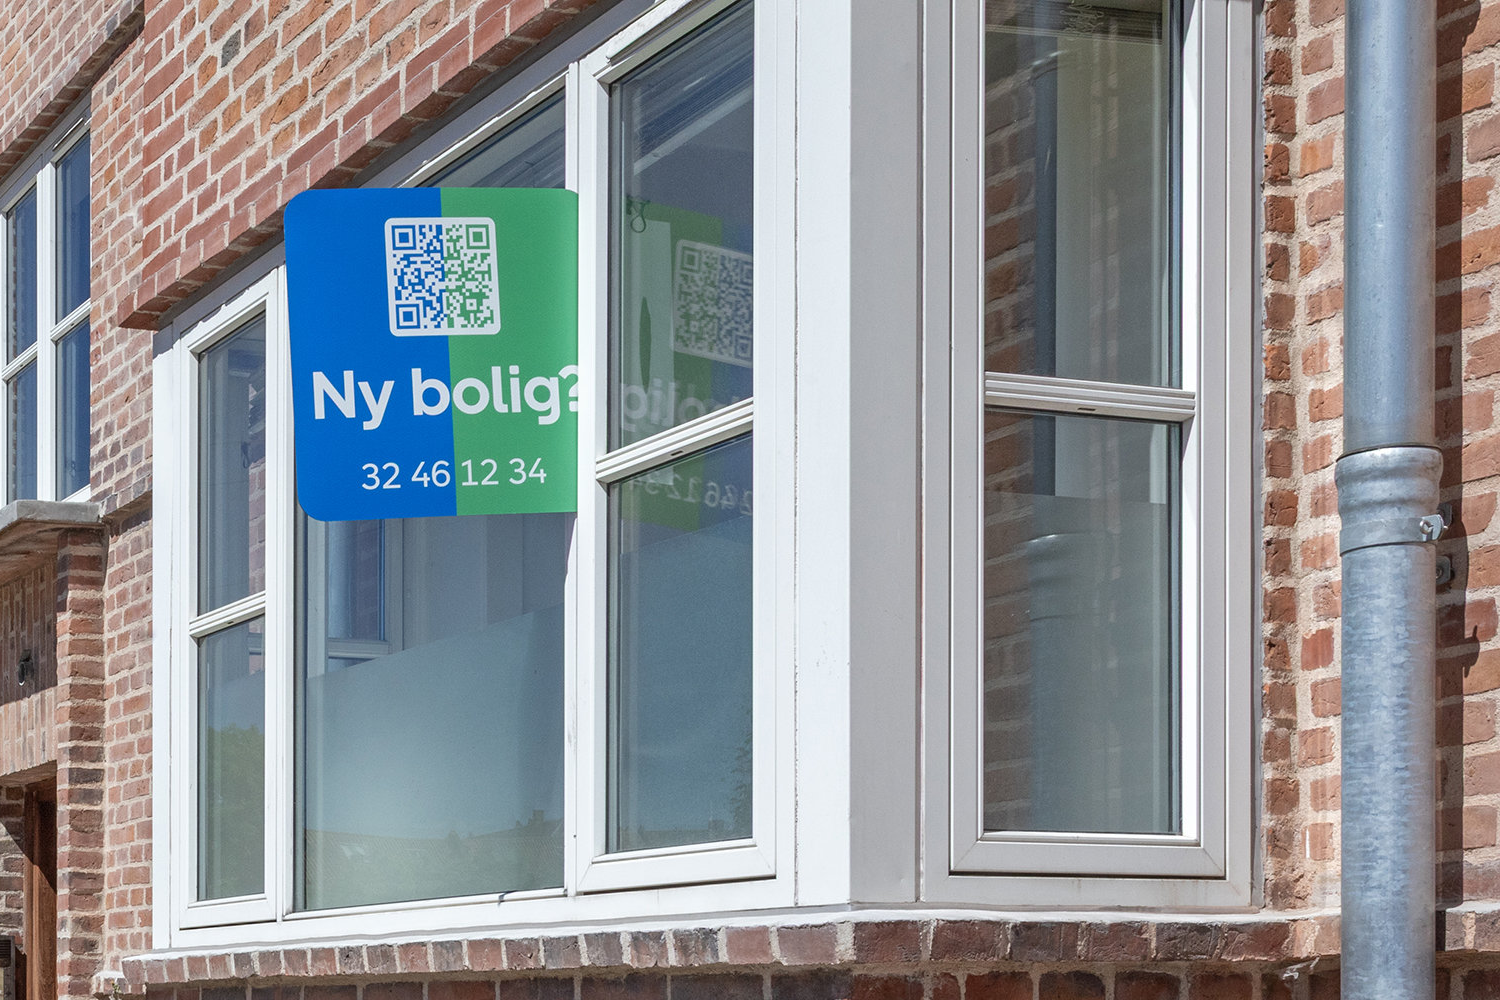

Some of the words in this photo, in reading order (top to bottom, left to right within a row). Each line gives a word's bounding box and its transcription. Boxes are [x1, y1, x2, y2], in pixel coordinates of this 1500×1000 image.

[312, 370, 396, 431] Ny
[411, 365, 579, 426] bolig?
[361, 462, 402, 491] 32
[411, 460, 451, 488] 46
[461, 458, 500, 486] 12
[508, 457, 548, 485] 34
